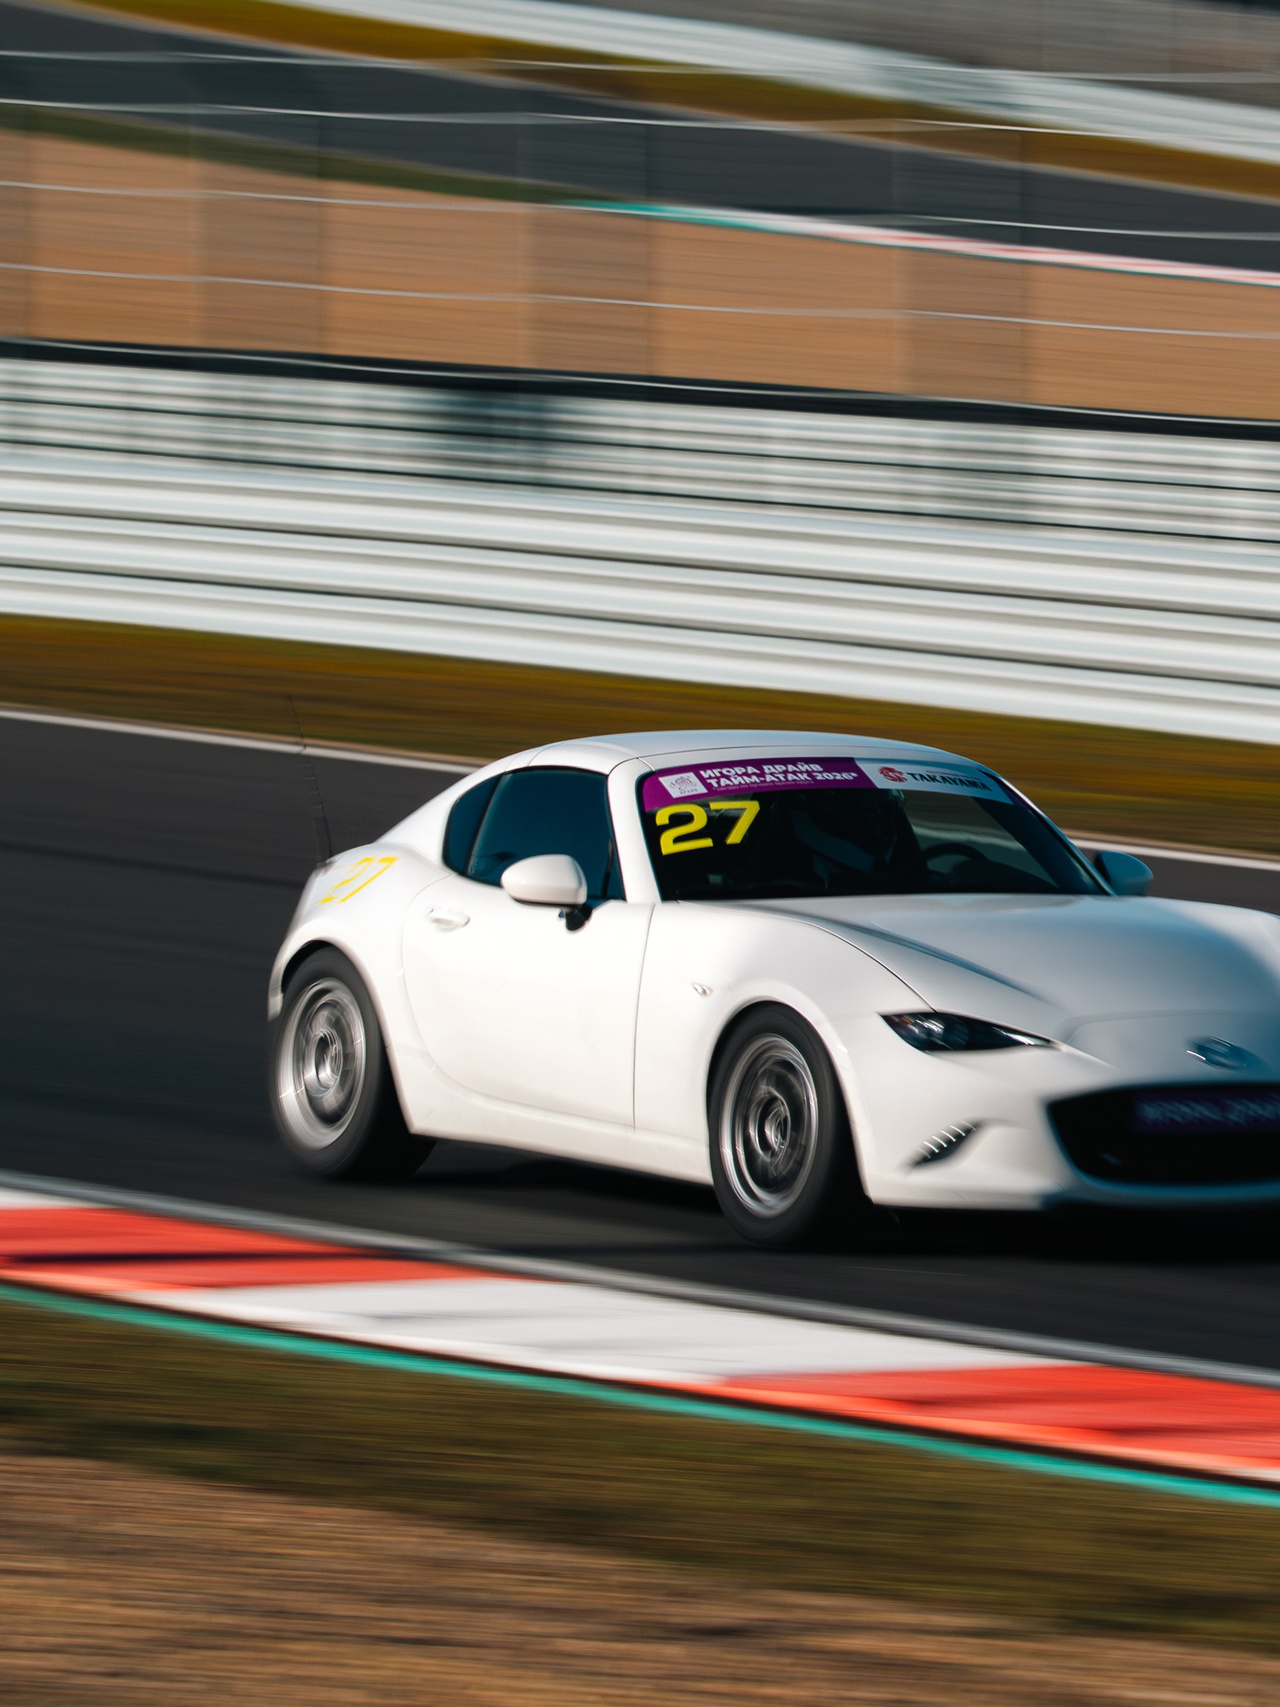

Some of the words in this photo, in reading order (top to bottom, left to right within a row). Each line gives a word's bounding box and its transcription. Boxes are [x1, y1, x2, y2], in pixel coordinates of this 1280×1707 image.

[700, 764, 760, 779] ИГОРА
[762, 762, 824, 775] ДРАЙВ
[706, 772, 811, 788] ТАЙМ-АТАК
[906, 772, 993, 792] TAKAYAMA
[655, 800, 761, 856] 27
[318, 856, 399, 905] 27
